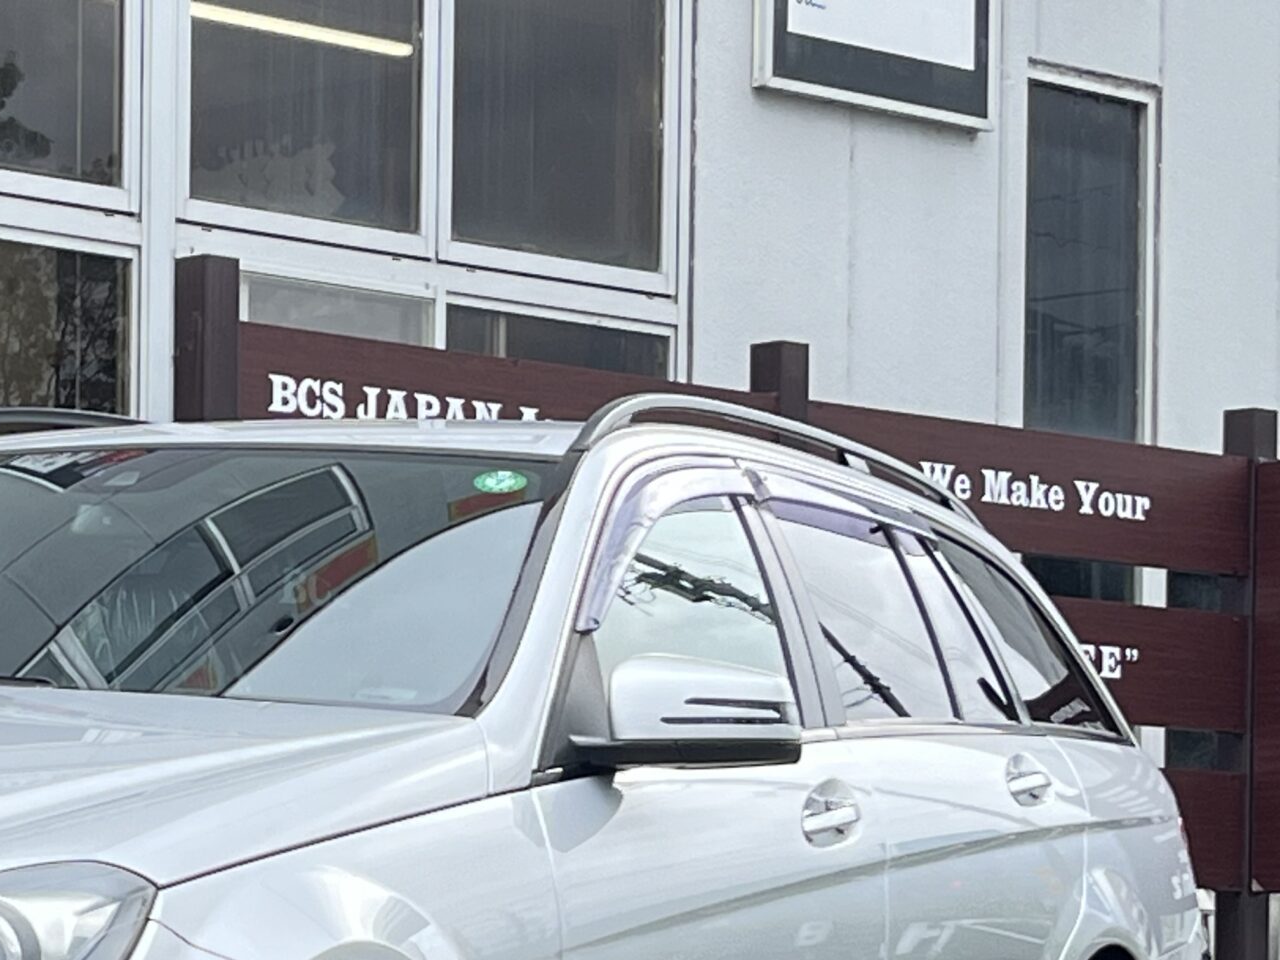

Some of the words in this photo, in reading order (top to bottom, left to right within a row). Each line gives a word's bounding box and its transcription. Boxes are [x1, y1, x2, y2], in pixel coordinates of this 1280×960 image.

[268, 373, 346, 419] BCS
[919, 461, 971, 500] We
[981, 468, 1065, 511] Make
[1074, 480, 1151, 521] Your
